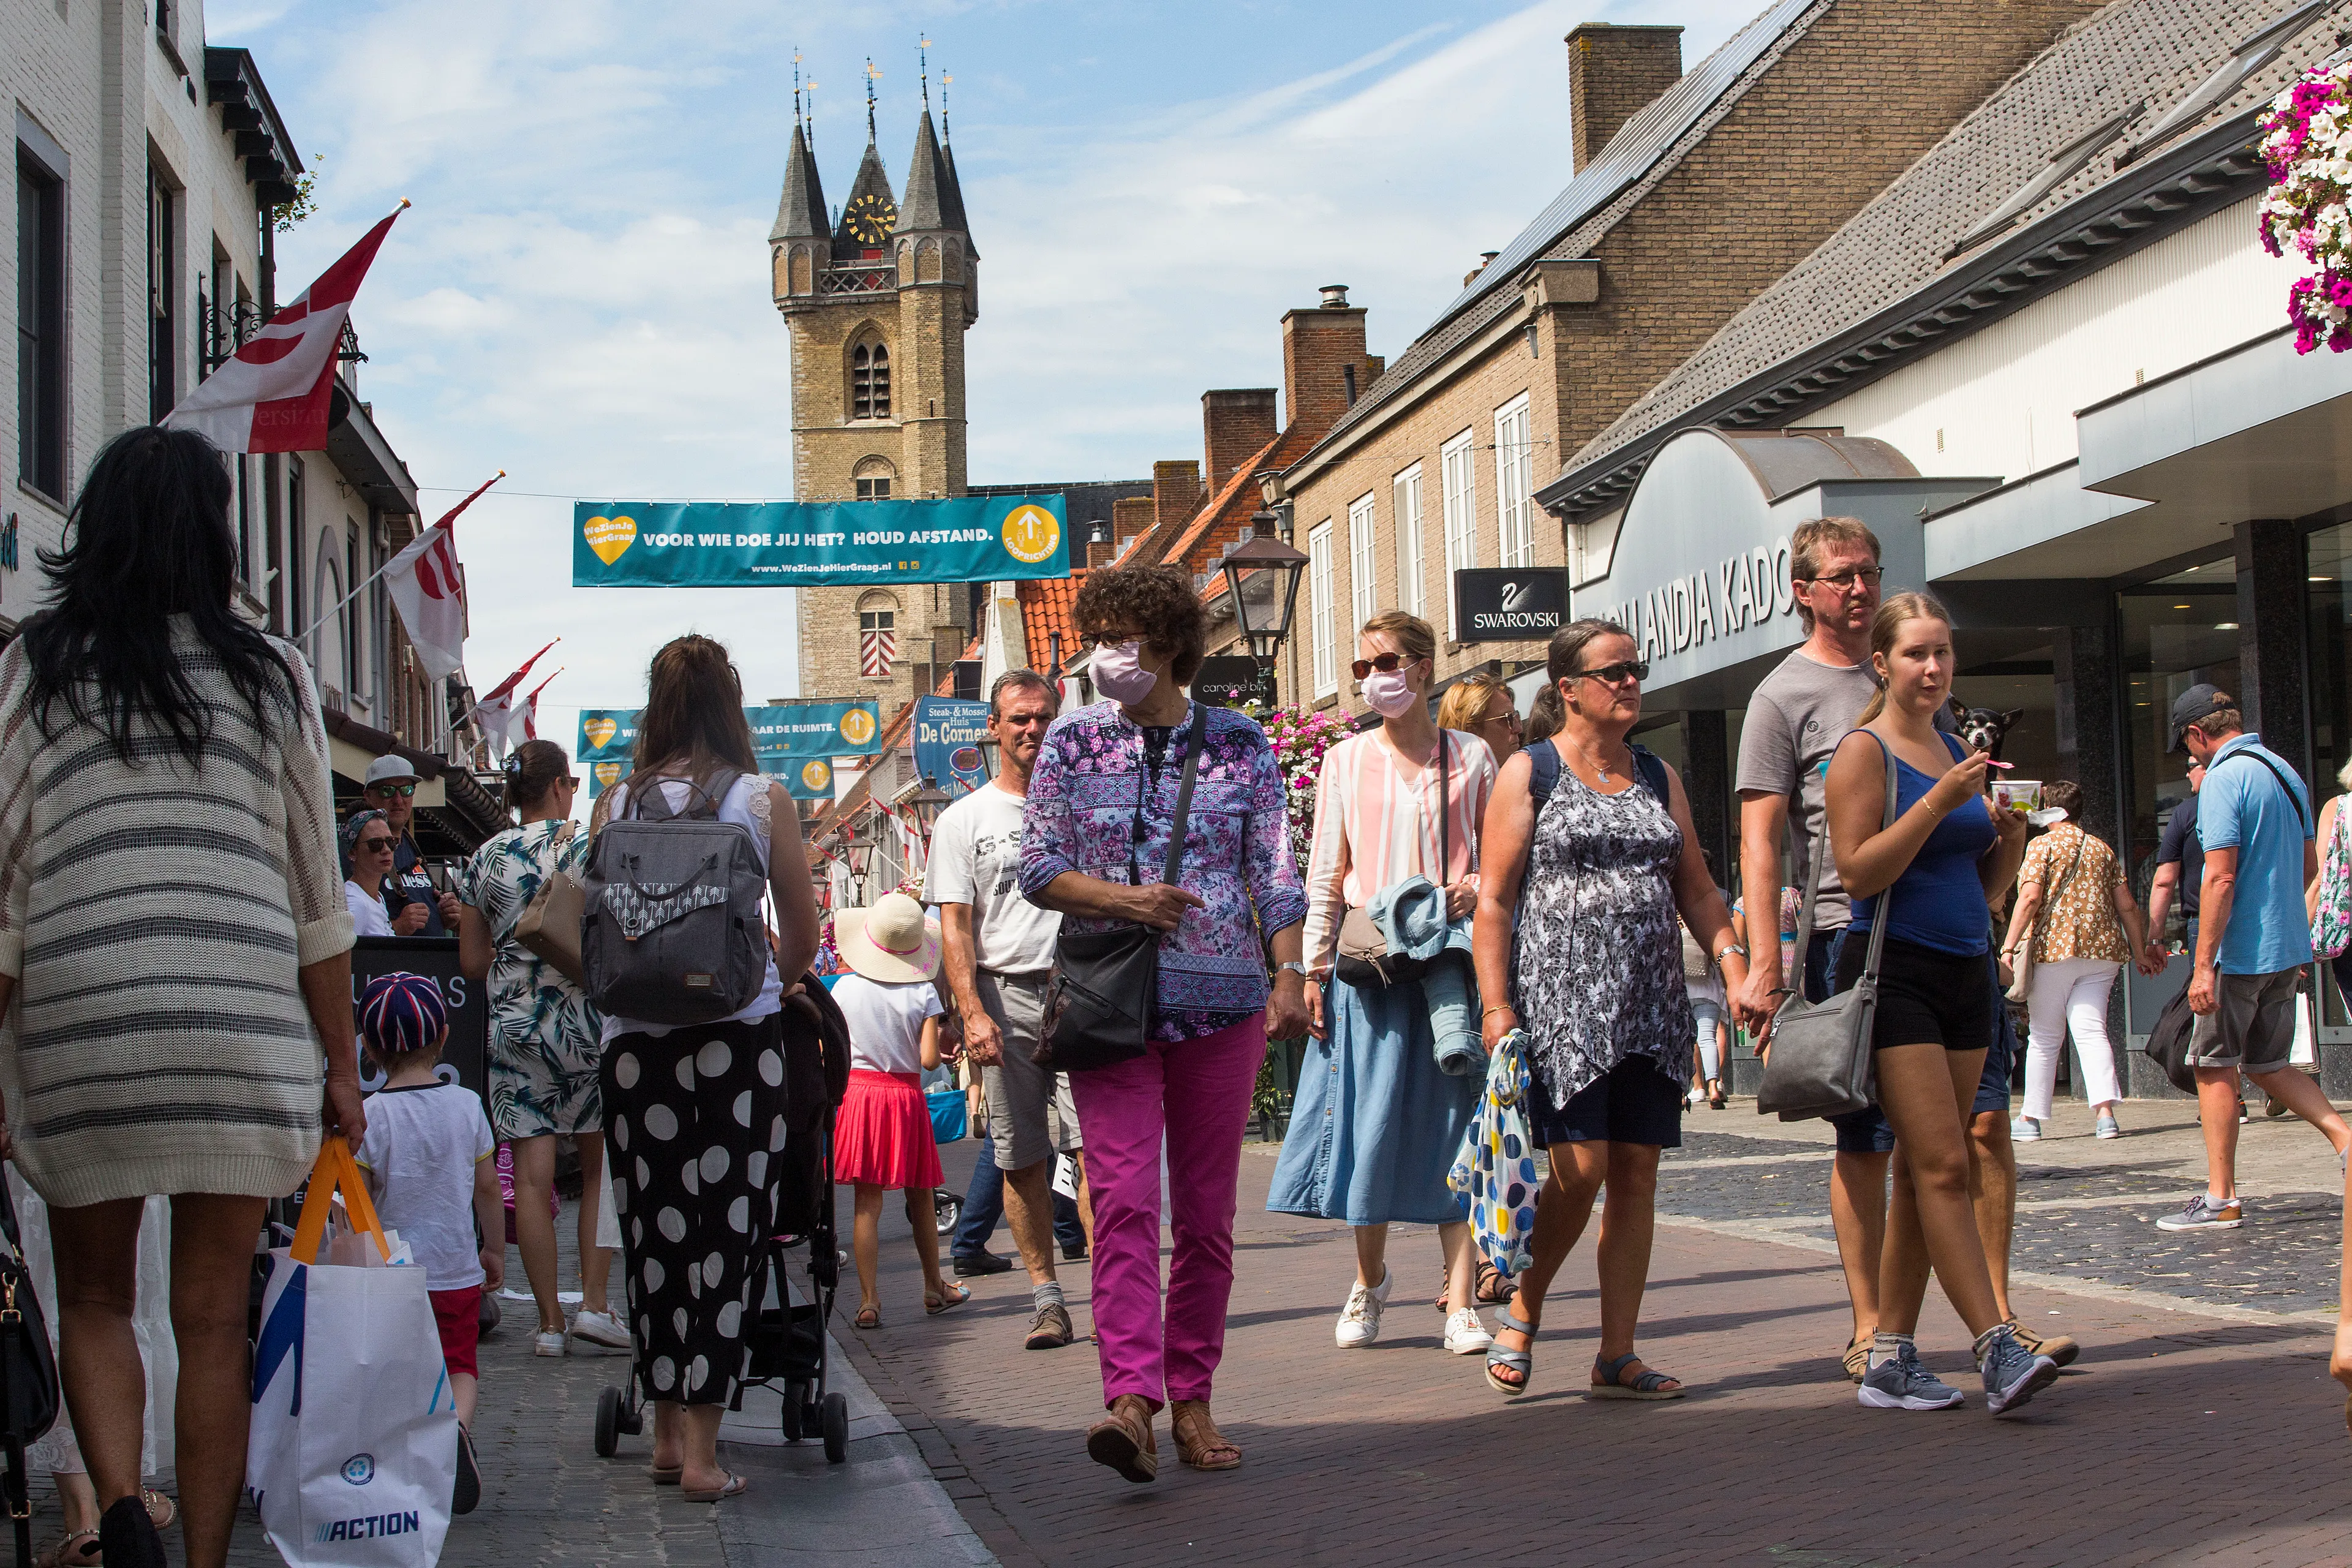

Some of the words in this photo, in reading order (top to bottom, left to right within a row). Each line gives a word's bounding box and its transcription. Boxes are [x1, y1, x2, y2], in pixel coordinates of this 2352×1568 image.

[584, 522, 633, 535] WeZienJe
[586, 533, 636, 546] HierGraag
[643, 533, 694, 546] VOOR
[698, 533, 732, 546] WIE
[736, 533, 772, 547] DOE
[775, 533, 800, 546] JIJ
[804, 533, 845, 546] HET?
[853, 532, 905, 545] HOUD
[909, 529, 993, 544] AFSTAND.
[1005, 533, 1058, 560] LOOPRICHTING
[752, 562, 892, 573] www.WeZienJeHierGraag.nl
[1474, 612, 1559, 628] SWAROVSKI
[1202, 682, 1247, 692] caroline
[929, 707, 952, 717] Steak-
[953, 706, 962, 717] &
[962, 707, 987, 716] Mossel
[950, 717, 970, 726] Huis
[776, 724, 790, 734] DE
[792, 723, 836, 733] RUIMTE.
[919, 722, 938, 744] De
[940, 722, 989, 745] Corner
[329, 1510, 418, 1542] ACTION
